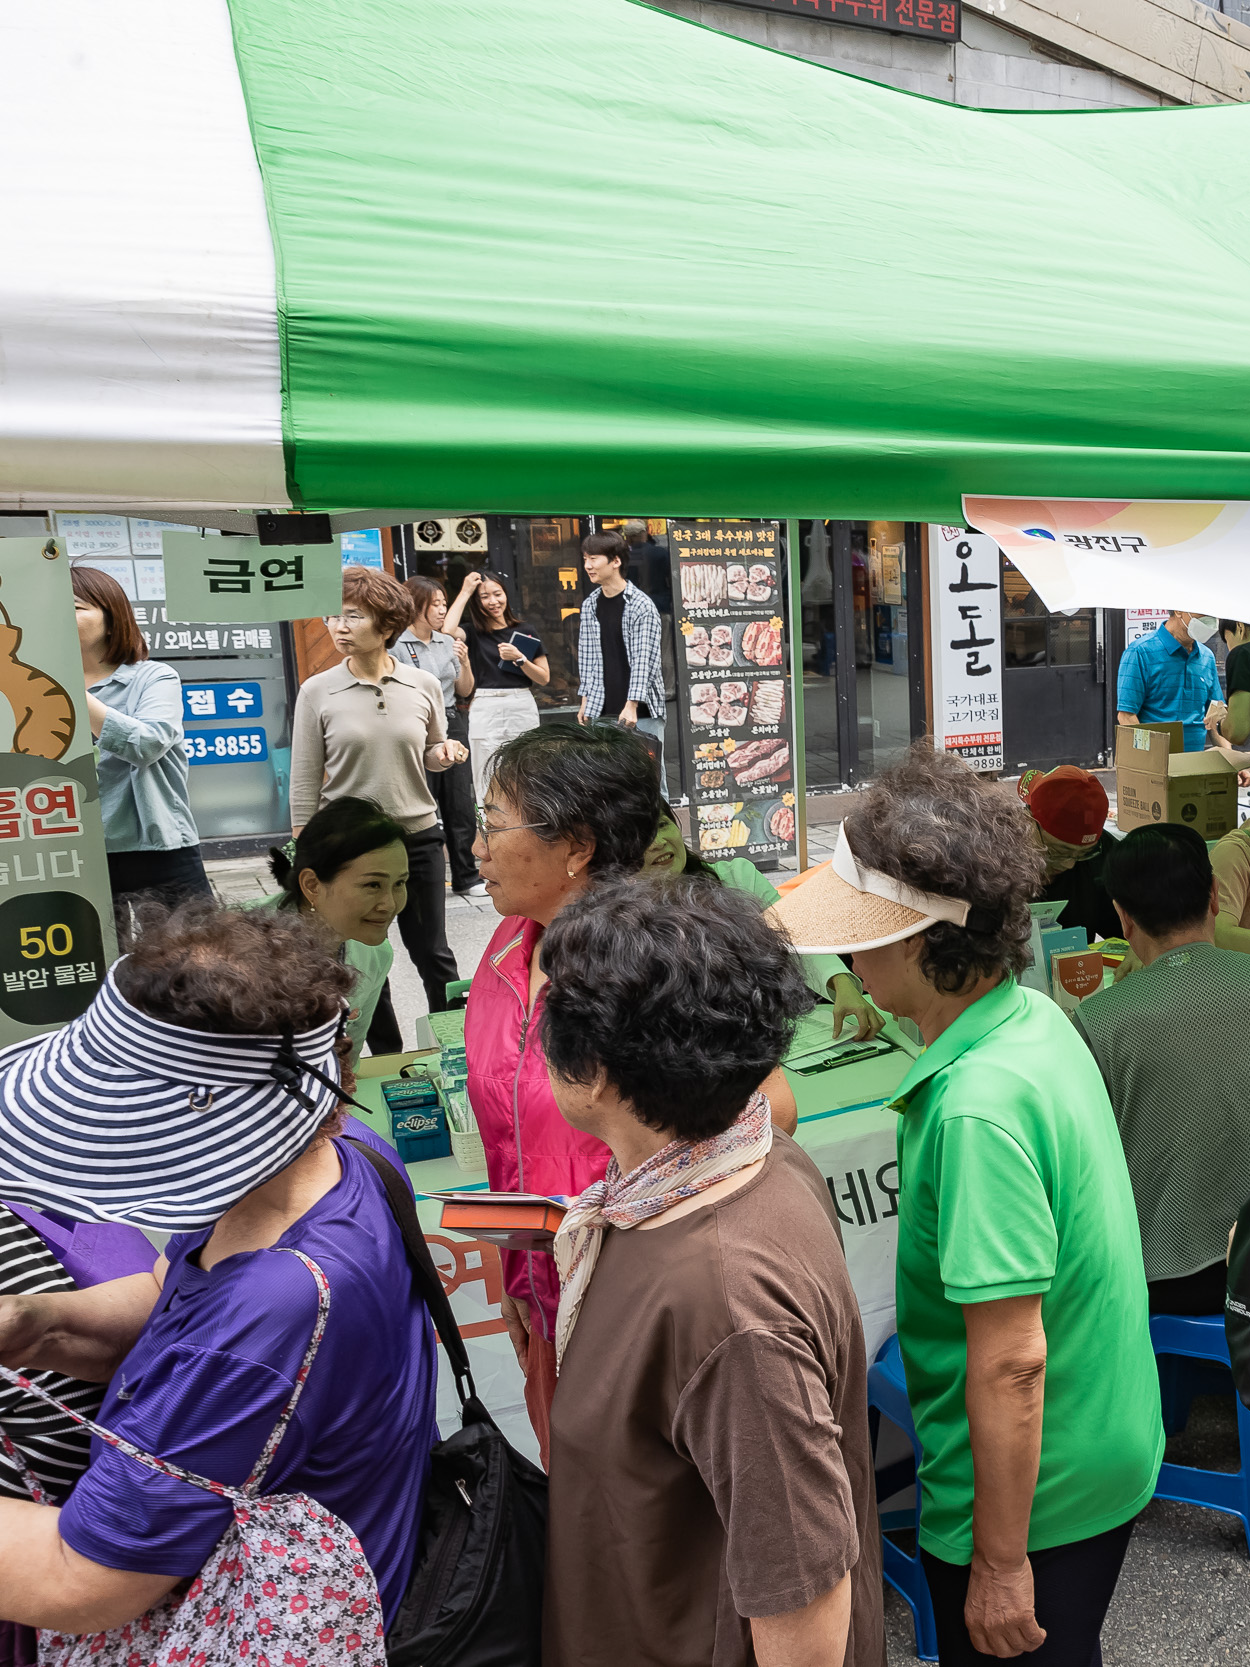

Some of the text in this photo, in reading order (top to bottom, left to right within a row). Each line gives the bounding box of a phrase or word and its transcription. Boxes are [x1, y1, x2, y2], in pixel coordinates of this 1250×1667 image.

[756, 530, 775, 543] 맛집
[1063, 533, 1148, 554] 광진구
[203, 555, 304, 593] 금연
[1142, 621, 1157, 631] 평일
[164, 630, 221, 650] 오피스텔
[231, 629, 273, 650] 급매물
[946, 692, 999, 706] 국가대표
[947, 708, 999, 723] 고기맛집
[19, 923, 74, 960] 50
[3, 962, 98, 993] 발암 물질
[396, 1116, 438, 1130] eclipse
